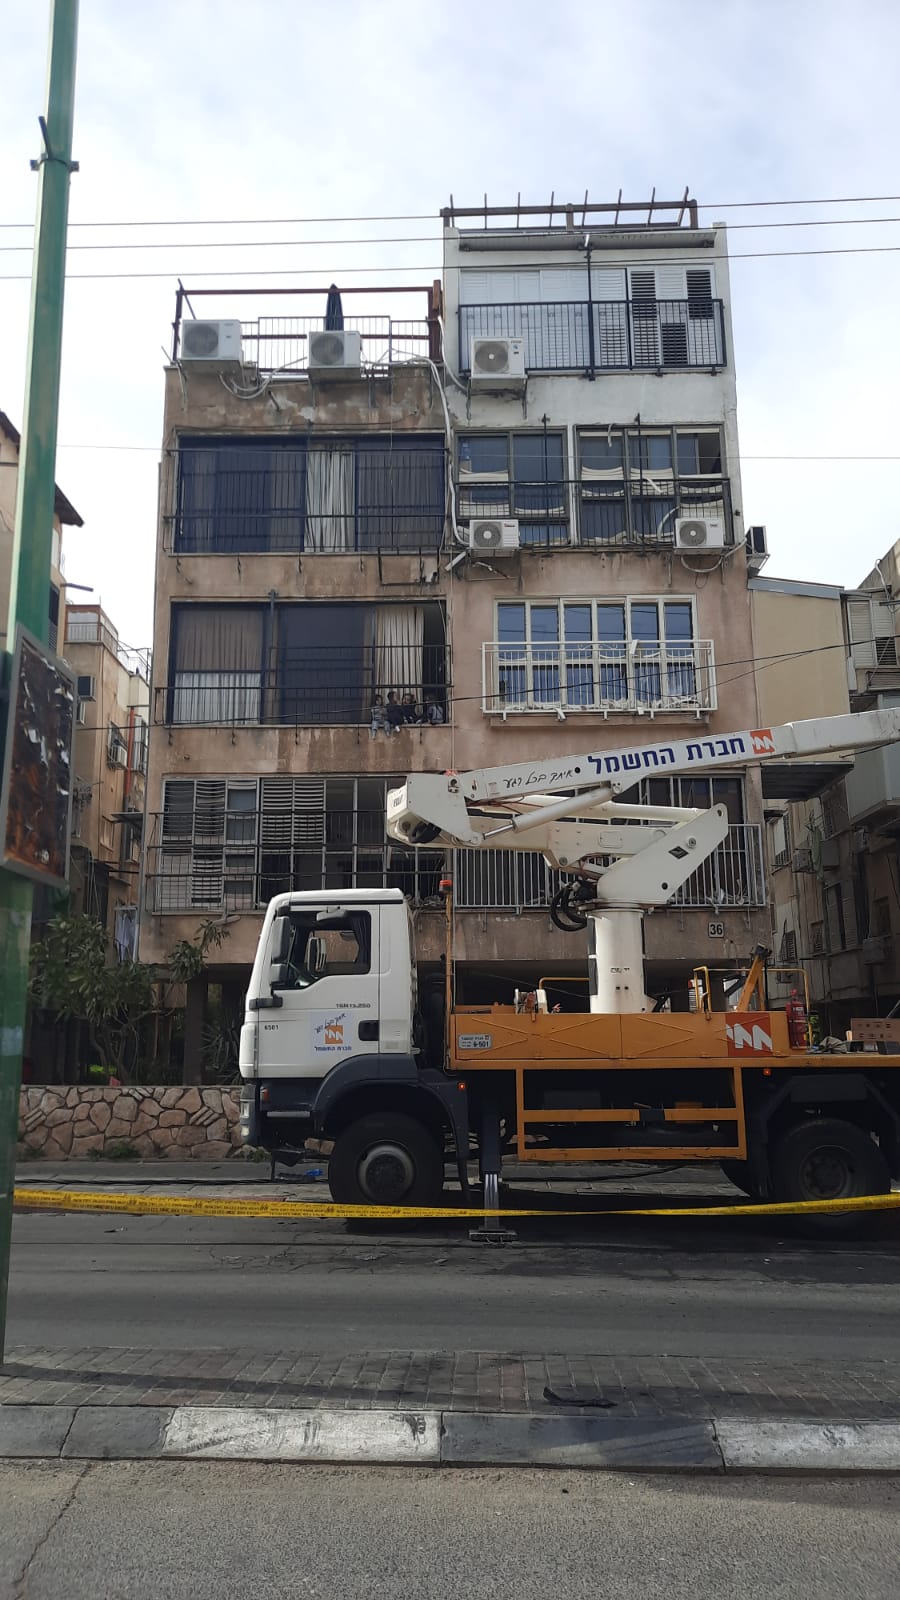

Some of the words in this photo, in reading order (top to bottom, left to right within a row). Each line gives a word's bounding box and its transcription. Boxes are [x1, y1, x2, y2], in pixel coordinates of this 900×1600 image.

[687, 737, 746, 761] חברת
[587, 747, 675, 774] החשמל
[503, 776, 523, 789] רגע
[526, 771, 547, 785] בכל
[709, 924, 723, 936] 36
